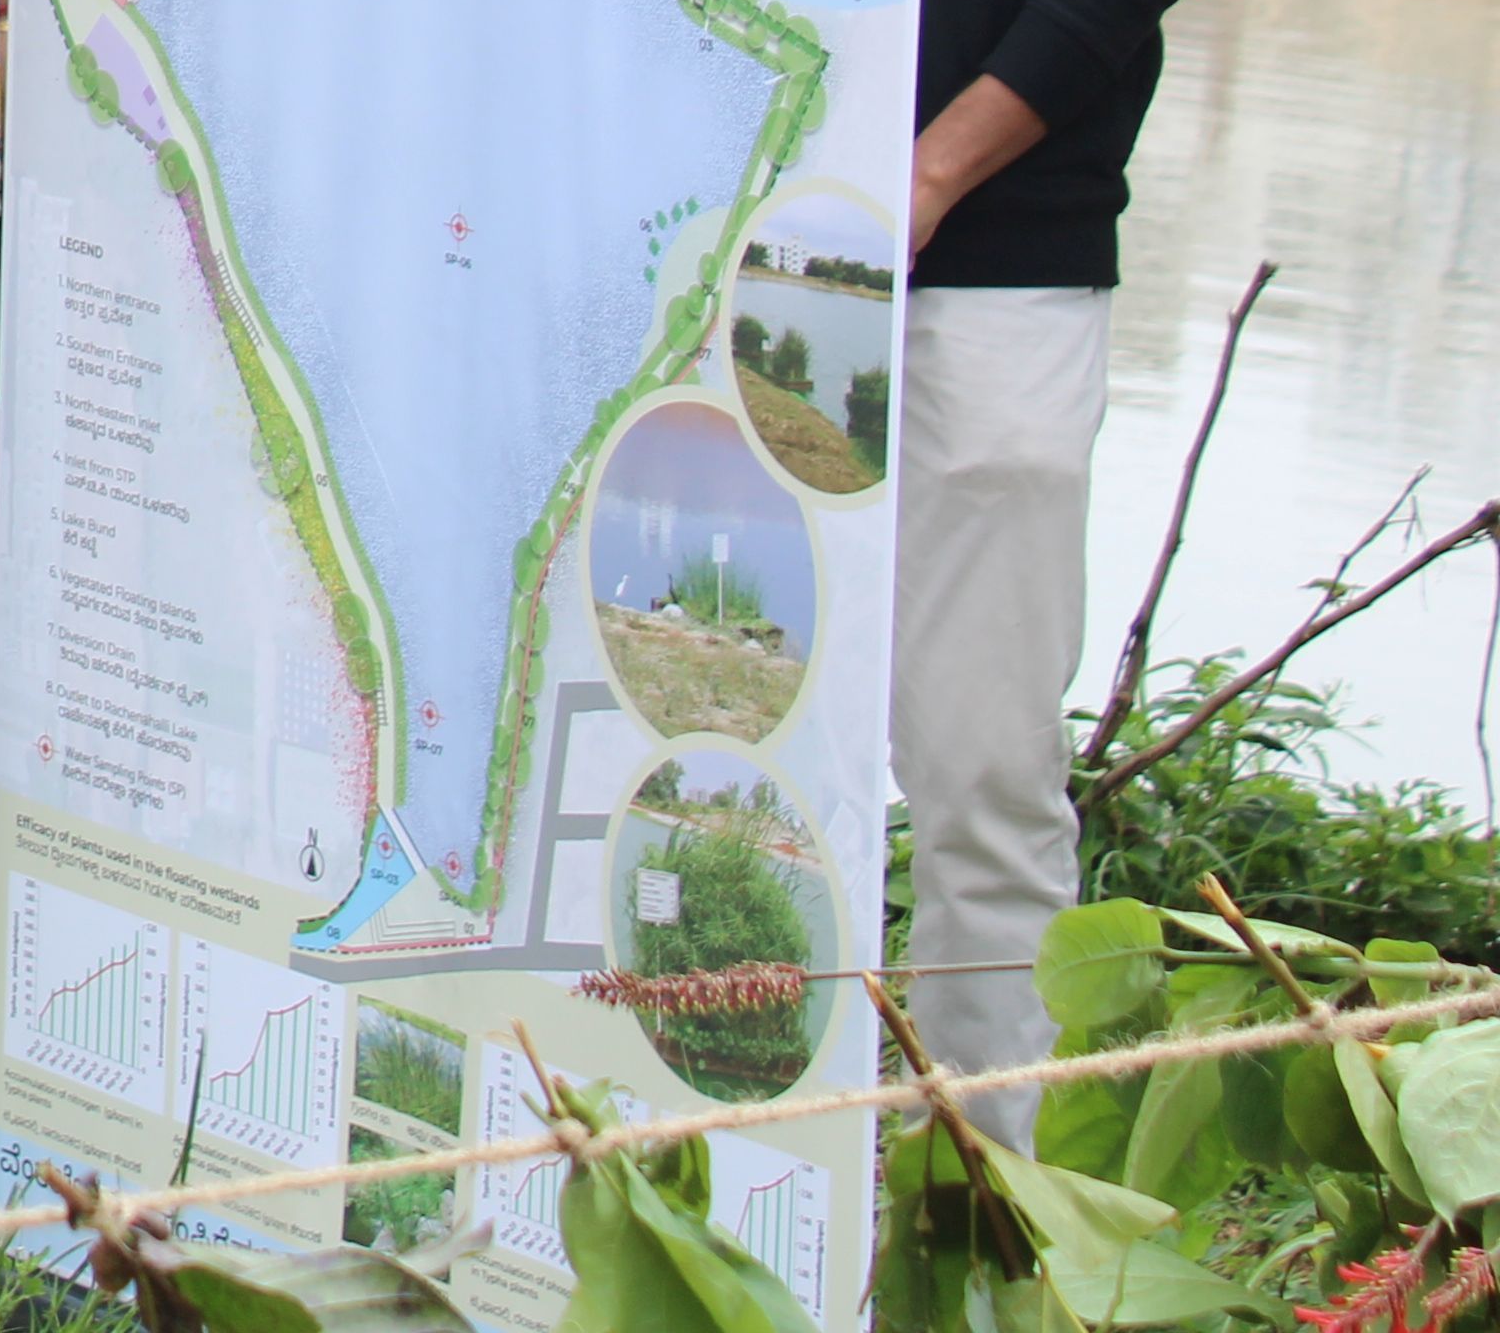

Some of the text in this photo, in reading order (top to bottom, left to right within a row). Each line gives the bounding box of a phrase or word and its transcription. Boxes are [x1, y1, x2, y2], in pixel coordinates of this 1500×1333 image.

[16, 816, 56, 843] Efficacy
[70, 837, 102, 857] plants
[105, 849, 130, 867] used
[144, 860, 162, 878] the
[164, 867, 206, 895] floating
[209, 885, 260, 911] wetlands
[308, 827, 318, 847] N
